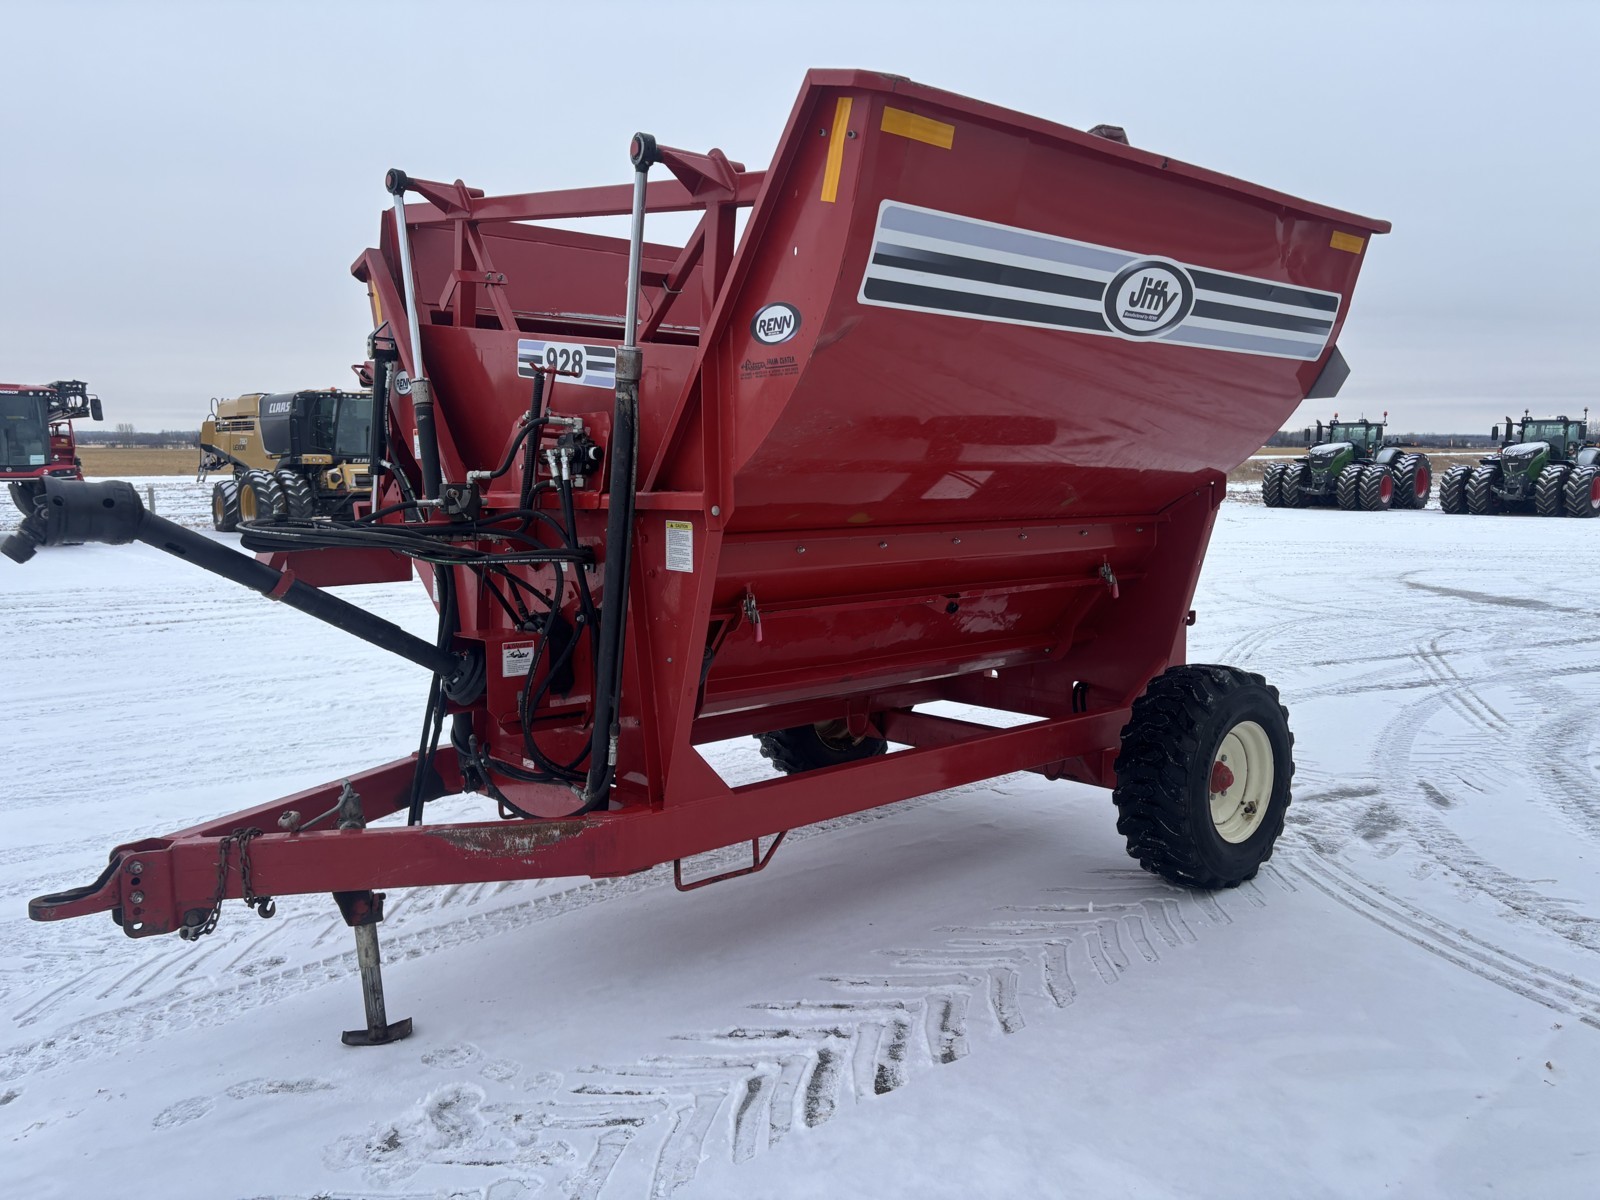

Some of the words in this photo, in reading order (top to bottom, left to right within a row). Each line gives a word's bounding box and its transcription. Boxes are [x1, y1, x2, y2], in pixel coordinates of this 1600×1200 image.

[1128, 276, 1179, 320] Jiffy
[758, 315, 792, 335] RENN
[546, 347, 583, 378] 928
[269, 402, 291, 413] CLAAS
